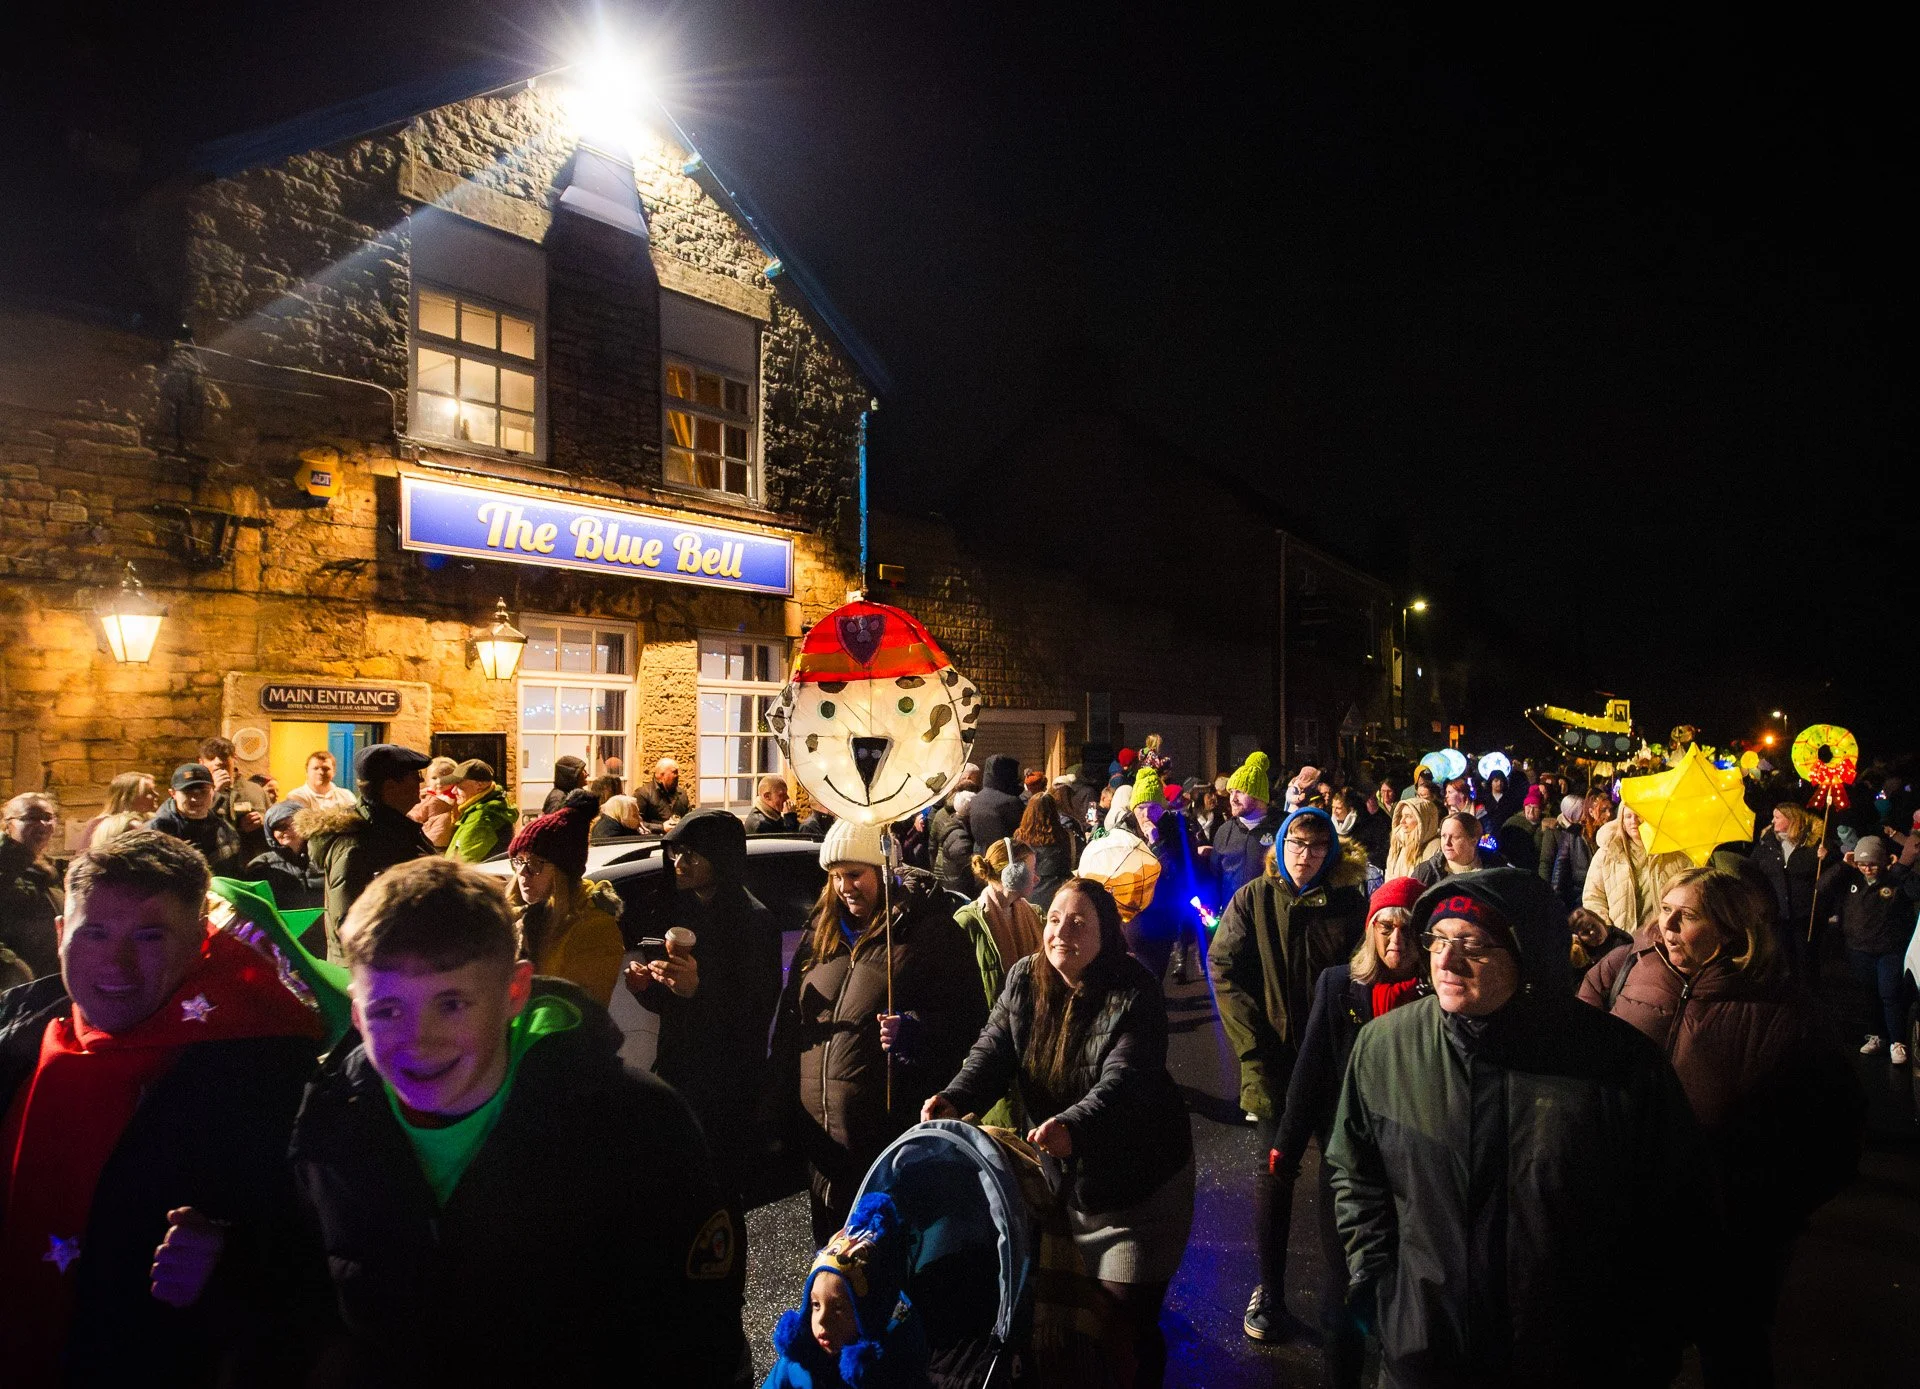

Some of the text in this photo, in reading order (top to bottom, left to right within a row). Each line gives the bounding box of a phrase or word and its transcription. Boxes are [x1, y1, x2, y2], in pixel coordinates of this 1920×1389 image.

[477, 502, 744, 579] The Blue Bell
[269, 688, 396, 706] MAIN ENTRANCE
